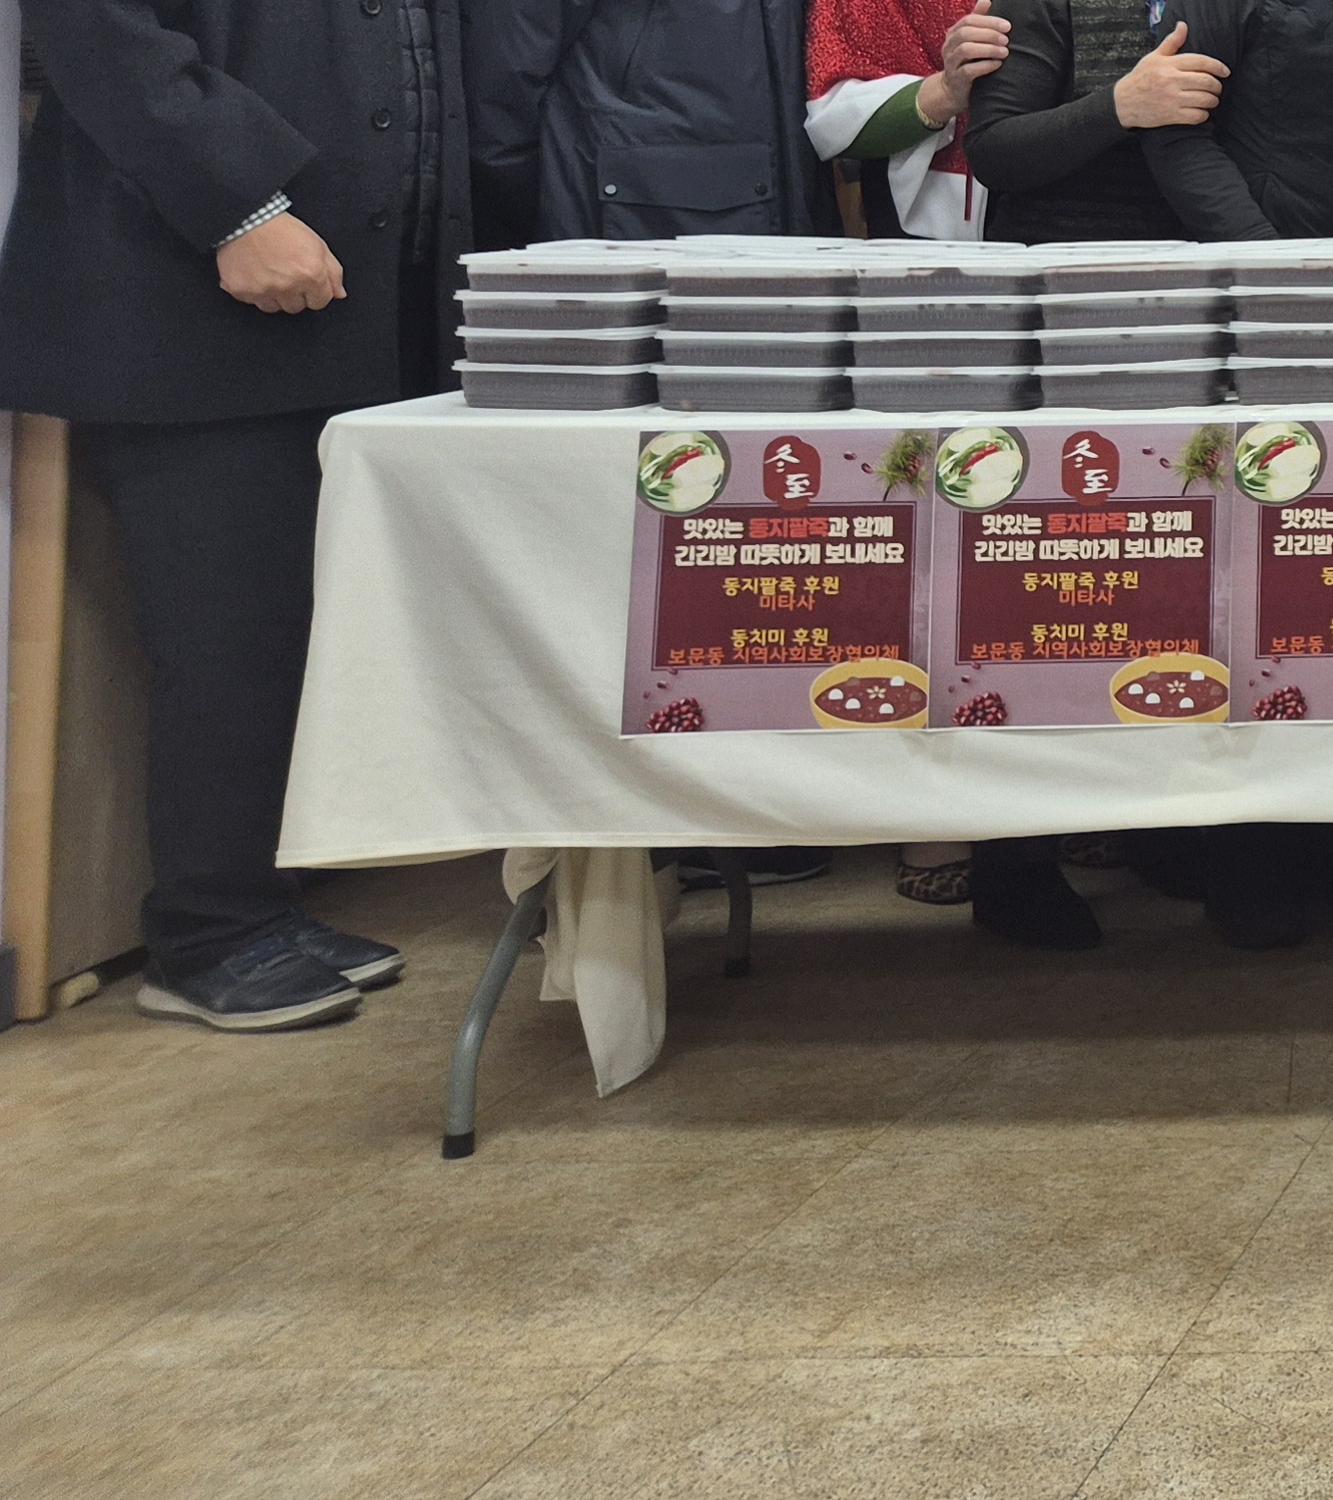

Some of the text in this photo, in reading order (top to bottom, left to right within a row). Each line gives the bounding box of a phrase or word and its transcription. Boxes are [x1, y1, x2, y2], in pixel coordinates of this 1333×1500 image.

[683, 519, 743, 539] 맛있는
[853, 516, 894, 538] 함께
[982, 511, 1193, 535] 맛있는 함께
[674, 543, 905, 566] 긴긴밤 따뜻하게 보내세요
[974, 538, 1204, 562] 긴긴밤 따뜻하게 보내세요
[803, 576, 840, 595] 후원
[1102, 571, 1139, 590] 후원
[759, 595, 816, 611] 미타사
[730, 628, 829, 648] 동치미 후원
[1031, 623, 1129, 643] 동치미 후원
[668, 647, 725, 665] 보문동
